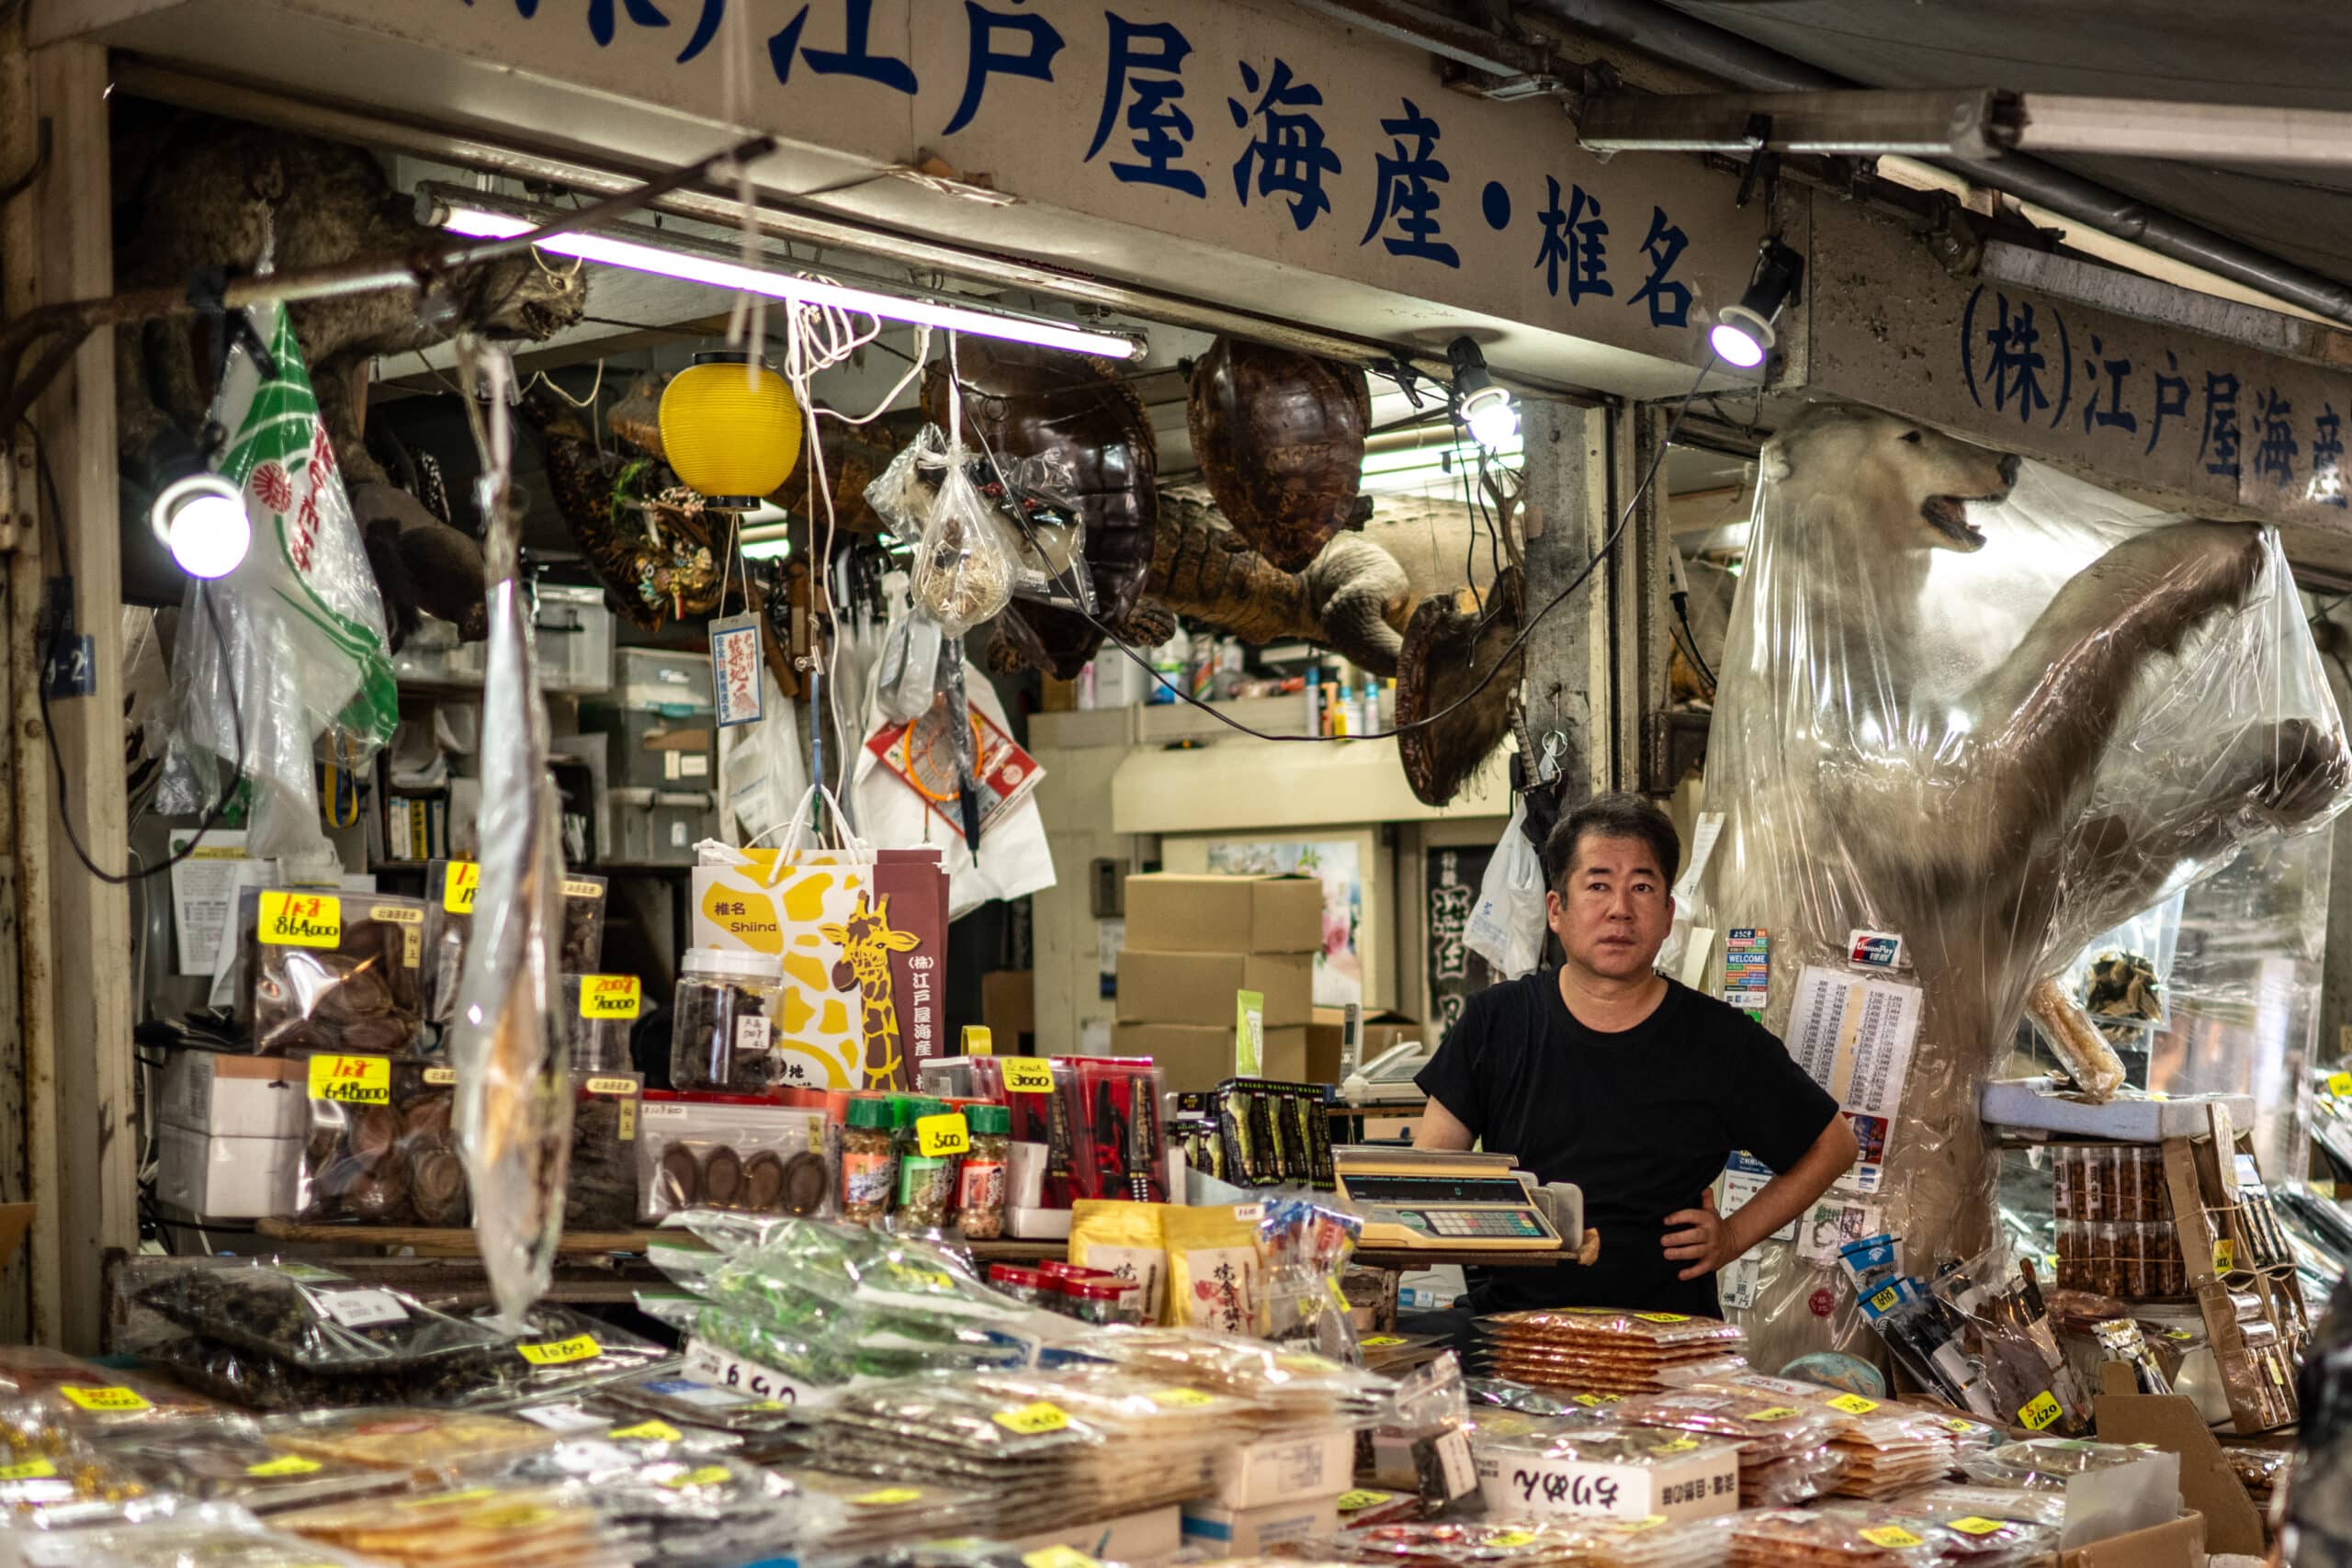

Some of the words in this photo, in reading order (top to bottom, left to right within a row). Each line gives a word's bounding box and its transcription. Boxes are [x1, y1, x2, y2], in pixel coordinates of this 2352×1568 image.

[714, 902, 746, 916] 椎名
[729, 921, 777, 933] Shiina
[1857, 941, 1894, 957] UnionPay
[1728, 954, 1766, 964] WELCOME
[908, 955, 934, 1056] (株)江戸屋海産
